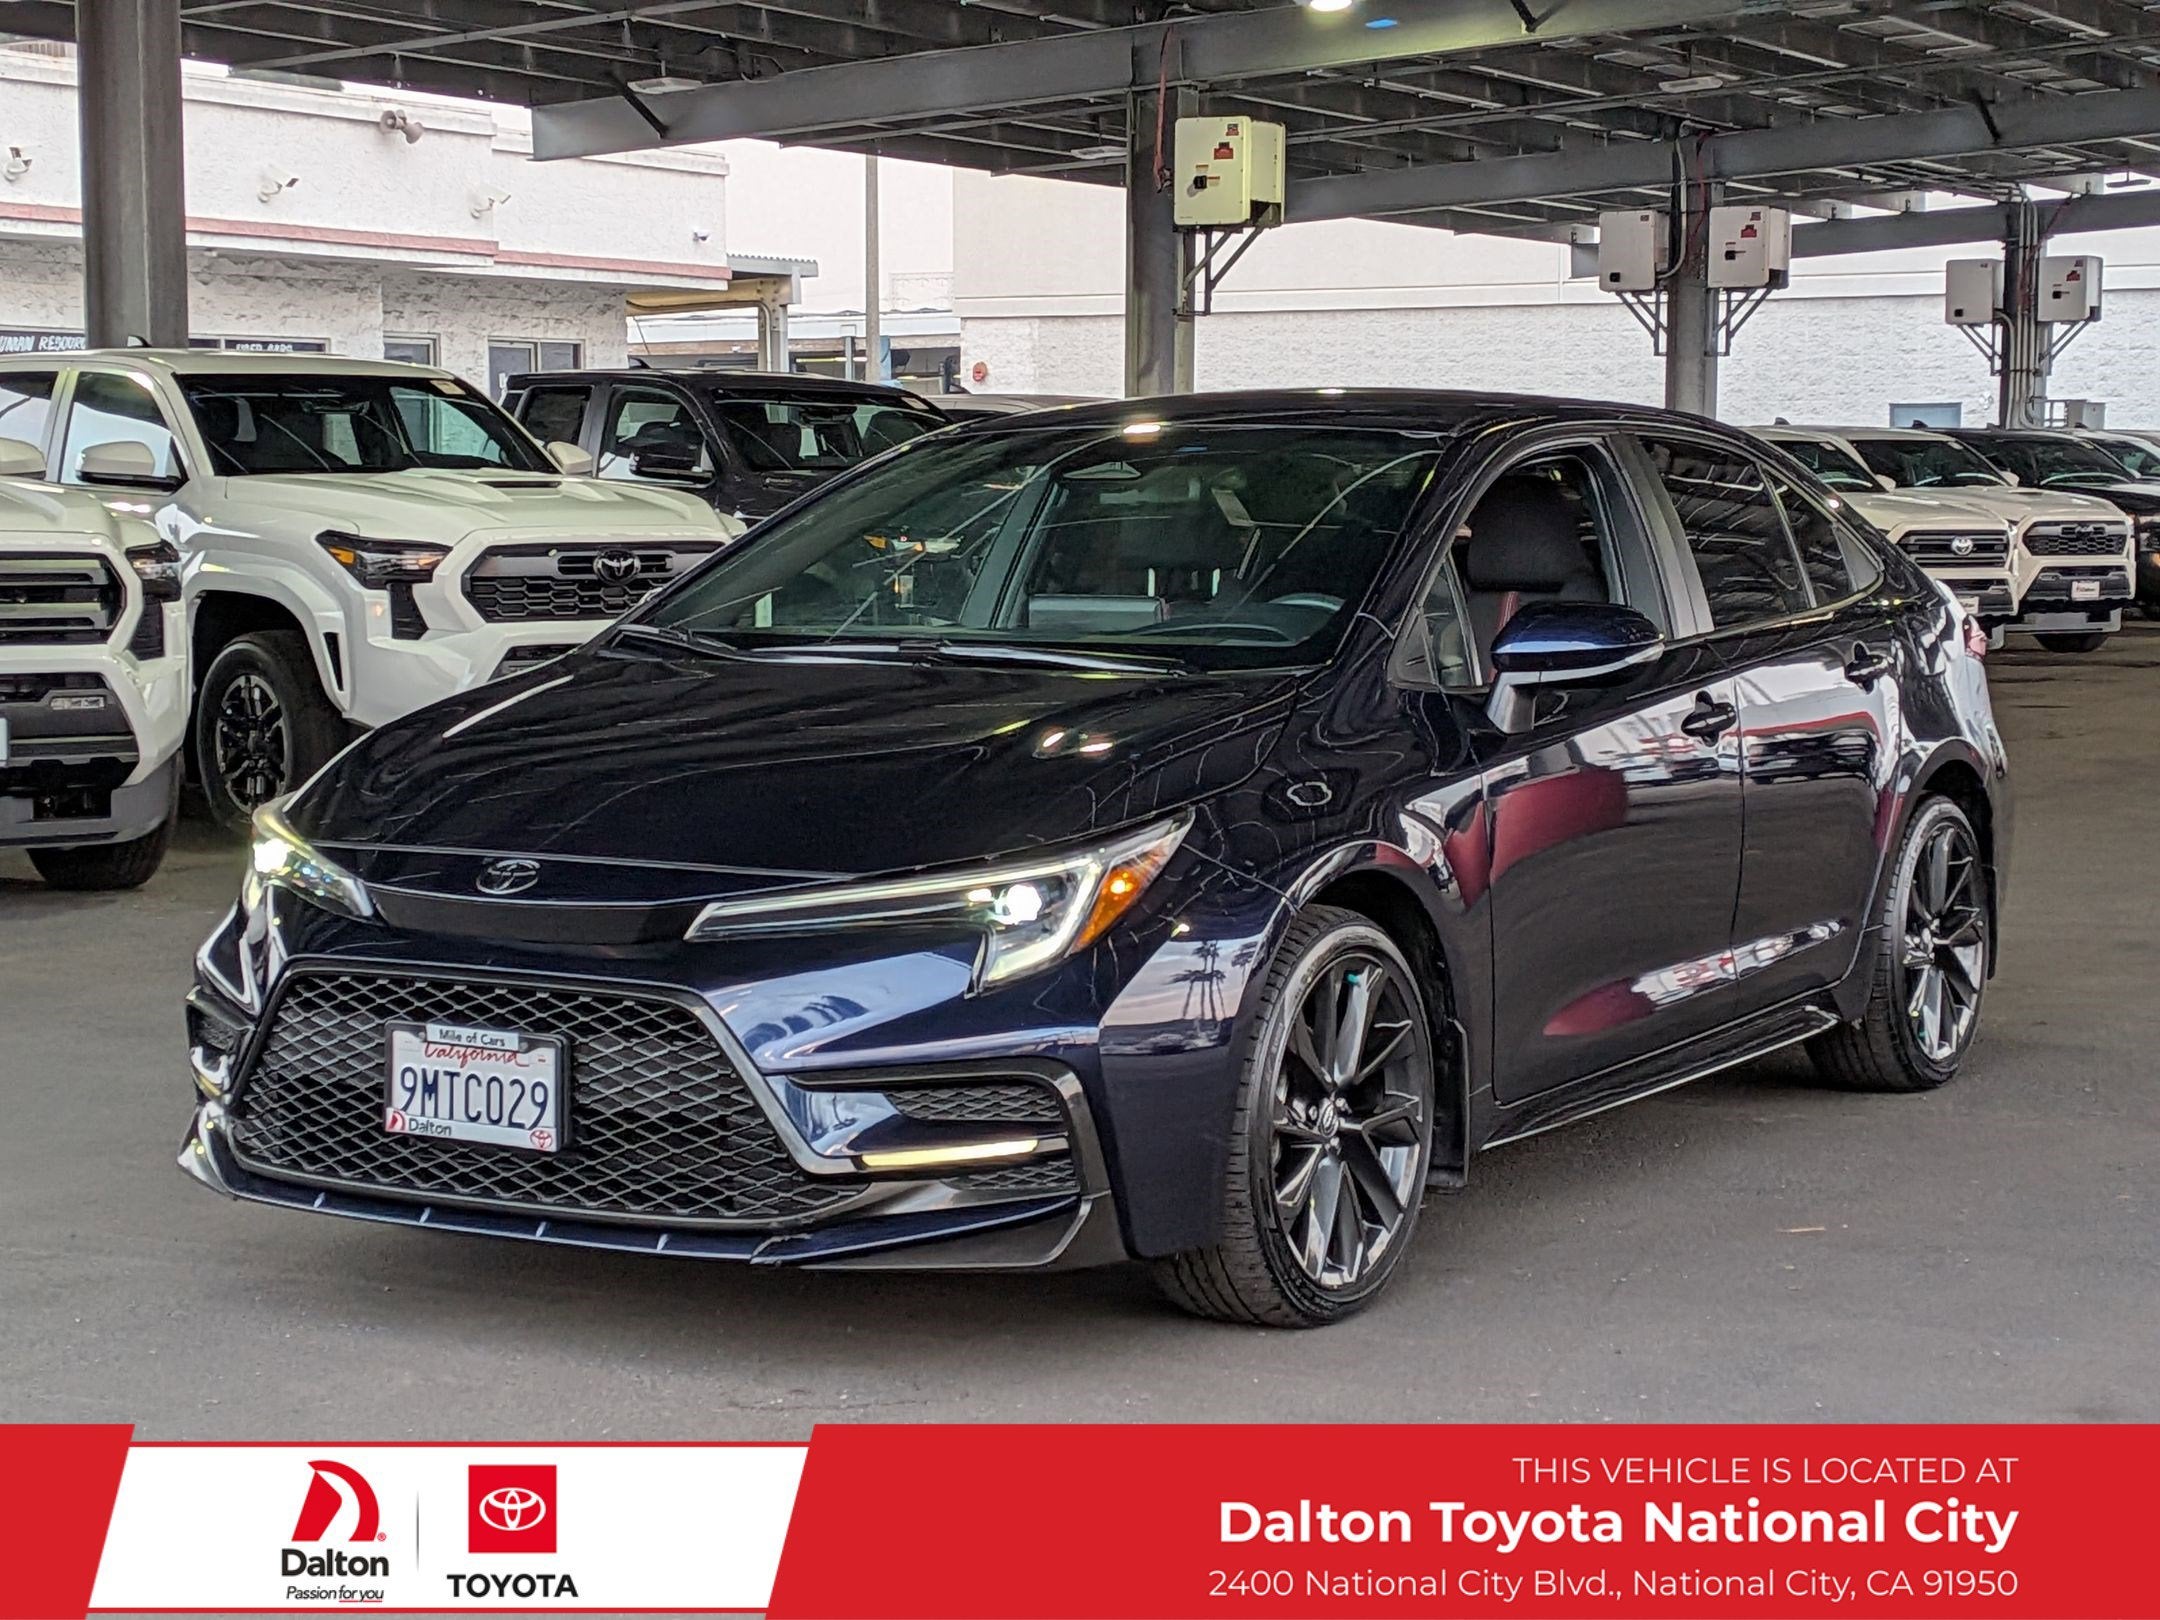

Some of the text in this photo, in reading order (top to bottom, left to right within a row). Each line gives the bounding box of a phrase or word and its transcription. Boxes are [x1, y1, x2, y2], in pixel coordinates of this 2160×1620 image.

[439, 1029, 506, 1046] Mile of Cars
[400, 1066, 549, 1130] 9MTC029
[408, 1117, 452, 1137] Dalton
